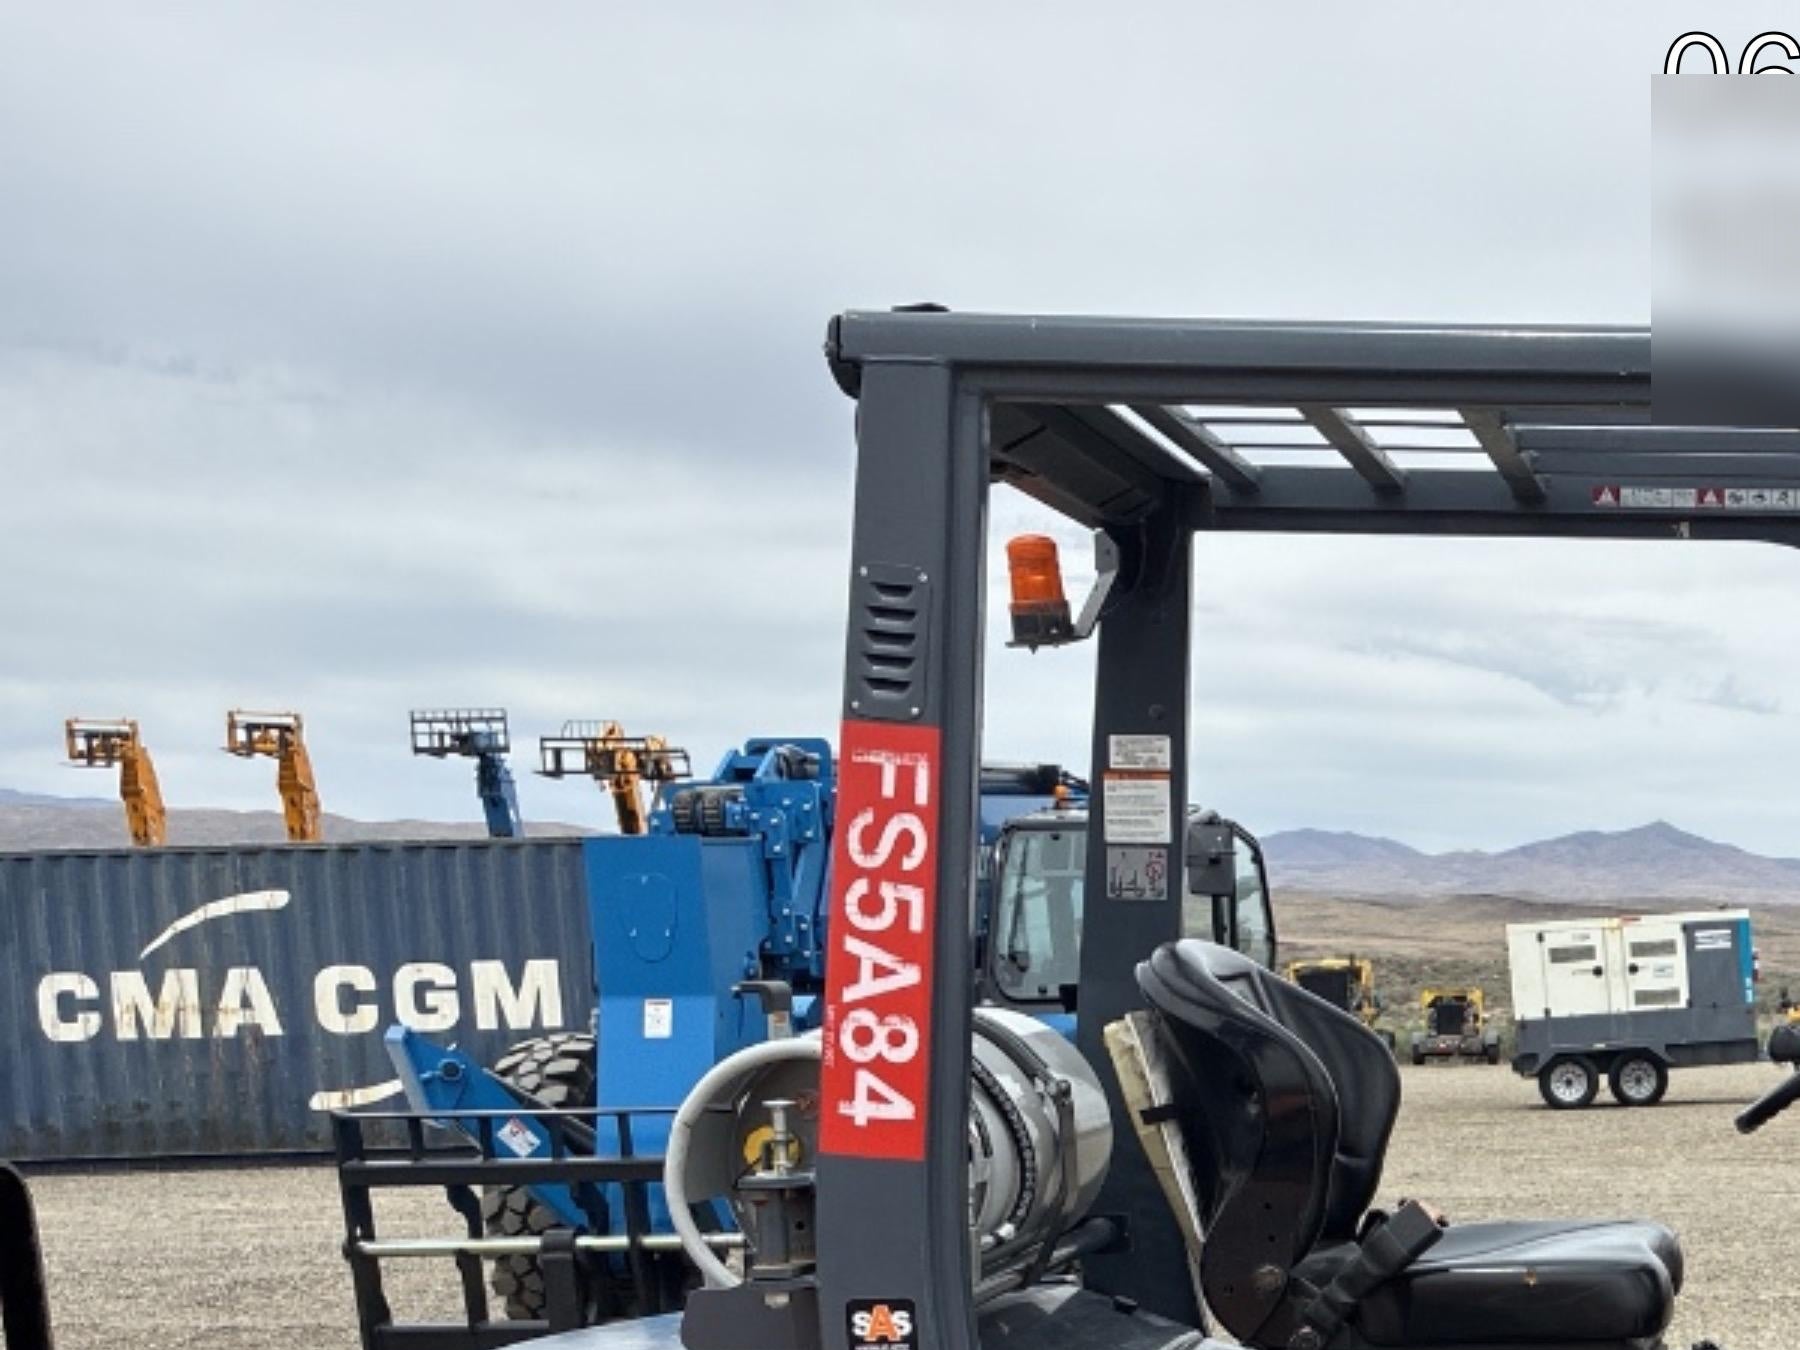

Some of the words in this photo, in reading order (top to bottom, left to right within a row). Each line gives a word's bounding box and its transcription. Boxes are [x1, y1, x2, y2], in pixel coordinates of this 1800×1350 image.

[838, 750, 929, 1127] FS5A84
[37, 966, 284, 1042] CMA
[313, 958, 564, 1035] CGM
[852, 1304, 912, 1342] SAS
